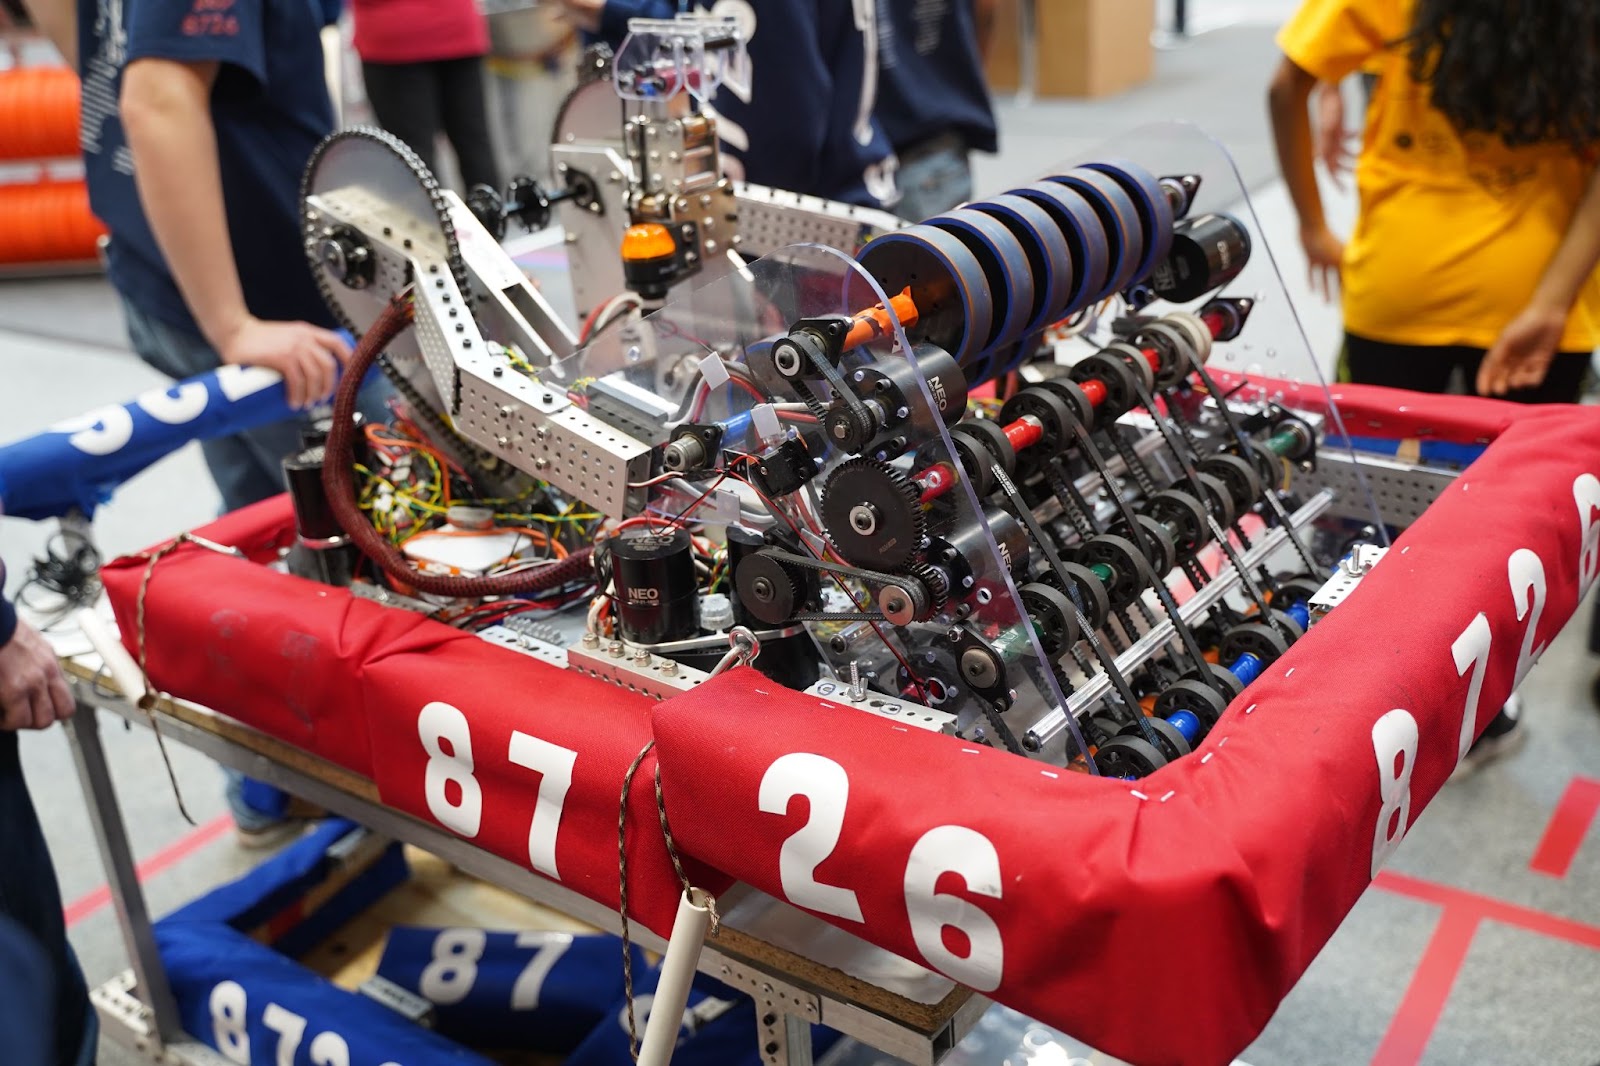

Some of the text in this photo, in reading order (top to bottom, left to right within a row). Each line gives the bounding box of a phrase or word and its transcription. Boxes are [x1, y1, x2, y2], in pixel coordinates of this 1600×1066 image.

[931, 376, 947, 411] NEO
[628, 587, 659, 600] NEO
[419, 927, 574, 1011] 87
